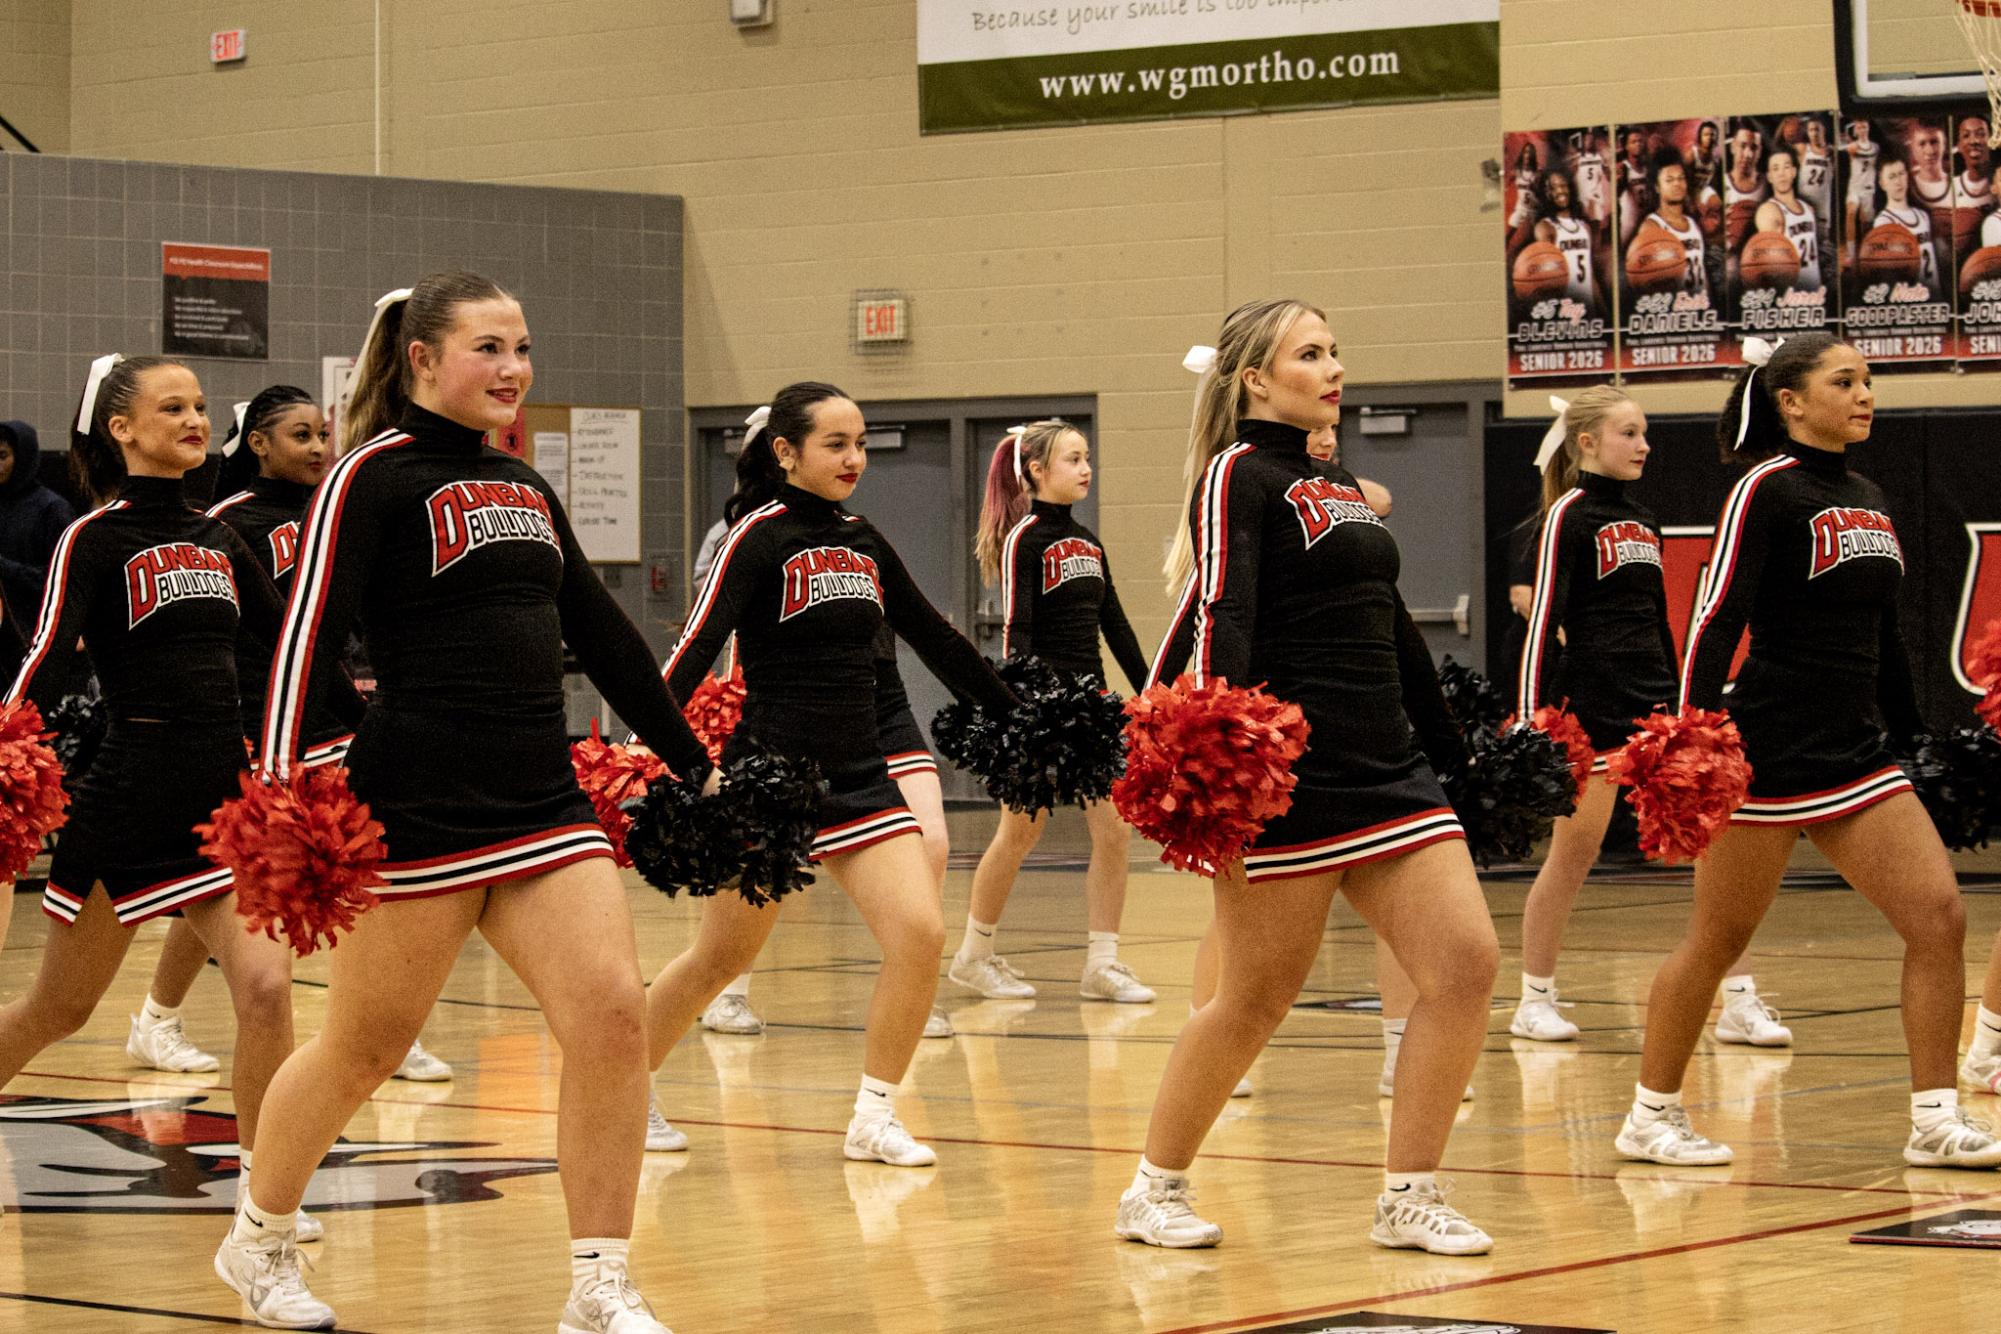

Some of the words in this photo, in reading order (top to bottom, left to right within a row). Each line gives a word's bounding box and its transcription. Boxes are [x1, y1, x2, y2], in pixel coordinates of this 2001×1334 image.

[972, 11, 1057, 31] Because
[1066, 5, 1119, 35] your
[1127, 0, 1188, 19] smile
[1197, 0, 1216, 12] is
[215, 32, 239, 59] EXIT
[1039, 50, 1400, 99] www.wgmortho.com
[1576, 254, 1586, 283] 5
[864, 304, 896, 336] EXIT
[1628, 310, 1718, 334] DANIELS
[1742, 306, 1825, 330] FISHER
[1845, 302, 1950, 327] GOODPASTER
[1632, 346, 1678, 367] SENIOR
[1681, 343, 1715, 363] 2026
[1854, 337, 1903, 357] SENIOR
[1906, 335, 1942, 356] 2026
[1520, 352, 1566, 372] SENIOR
[1568, 349, 1603, 369] 2026
